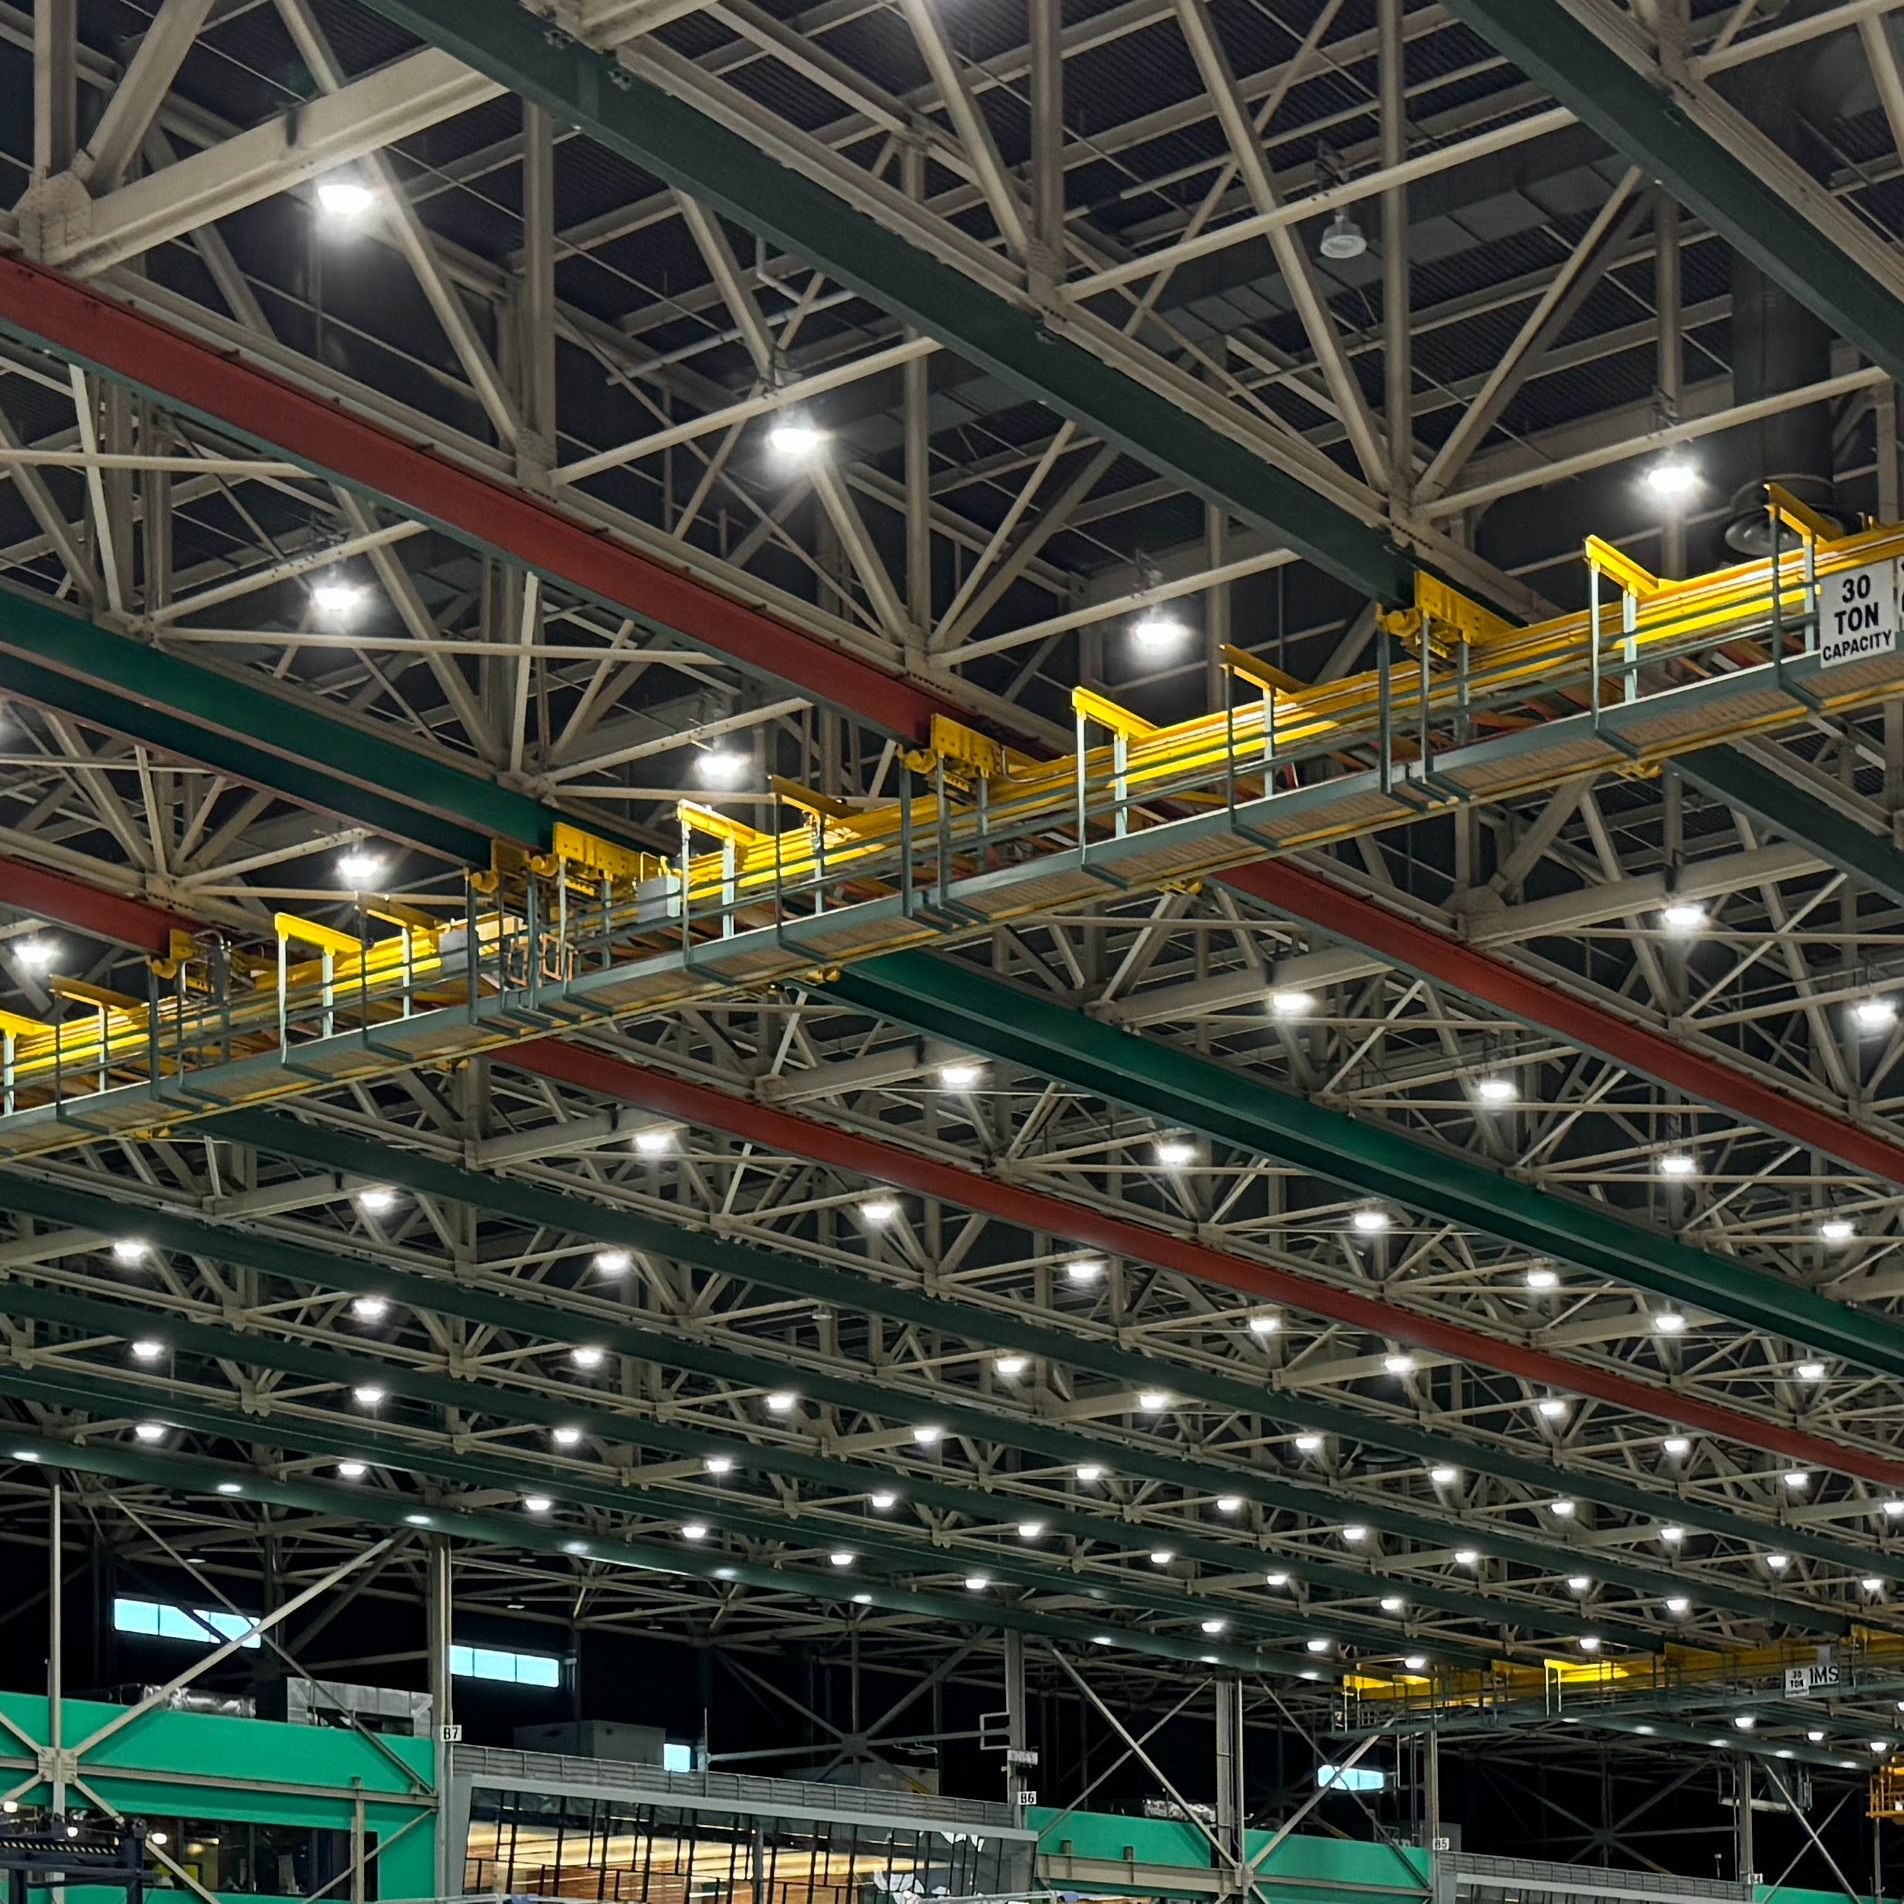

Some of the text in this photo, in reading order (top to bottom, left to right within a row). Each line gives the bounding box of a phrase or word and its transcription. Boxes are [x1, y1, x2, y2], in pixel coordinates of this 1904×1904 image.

[1842, 575, 1870, 603] 30
[1834, 602, 1879, 635] TON
[1822, 629, 1892, 661] CAPACITY
